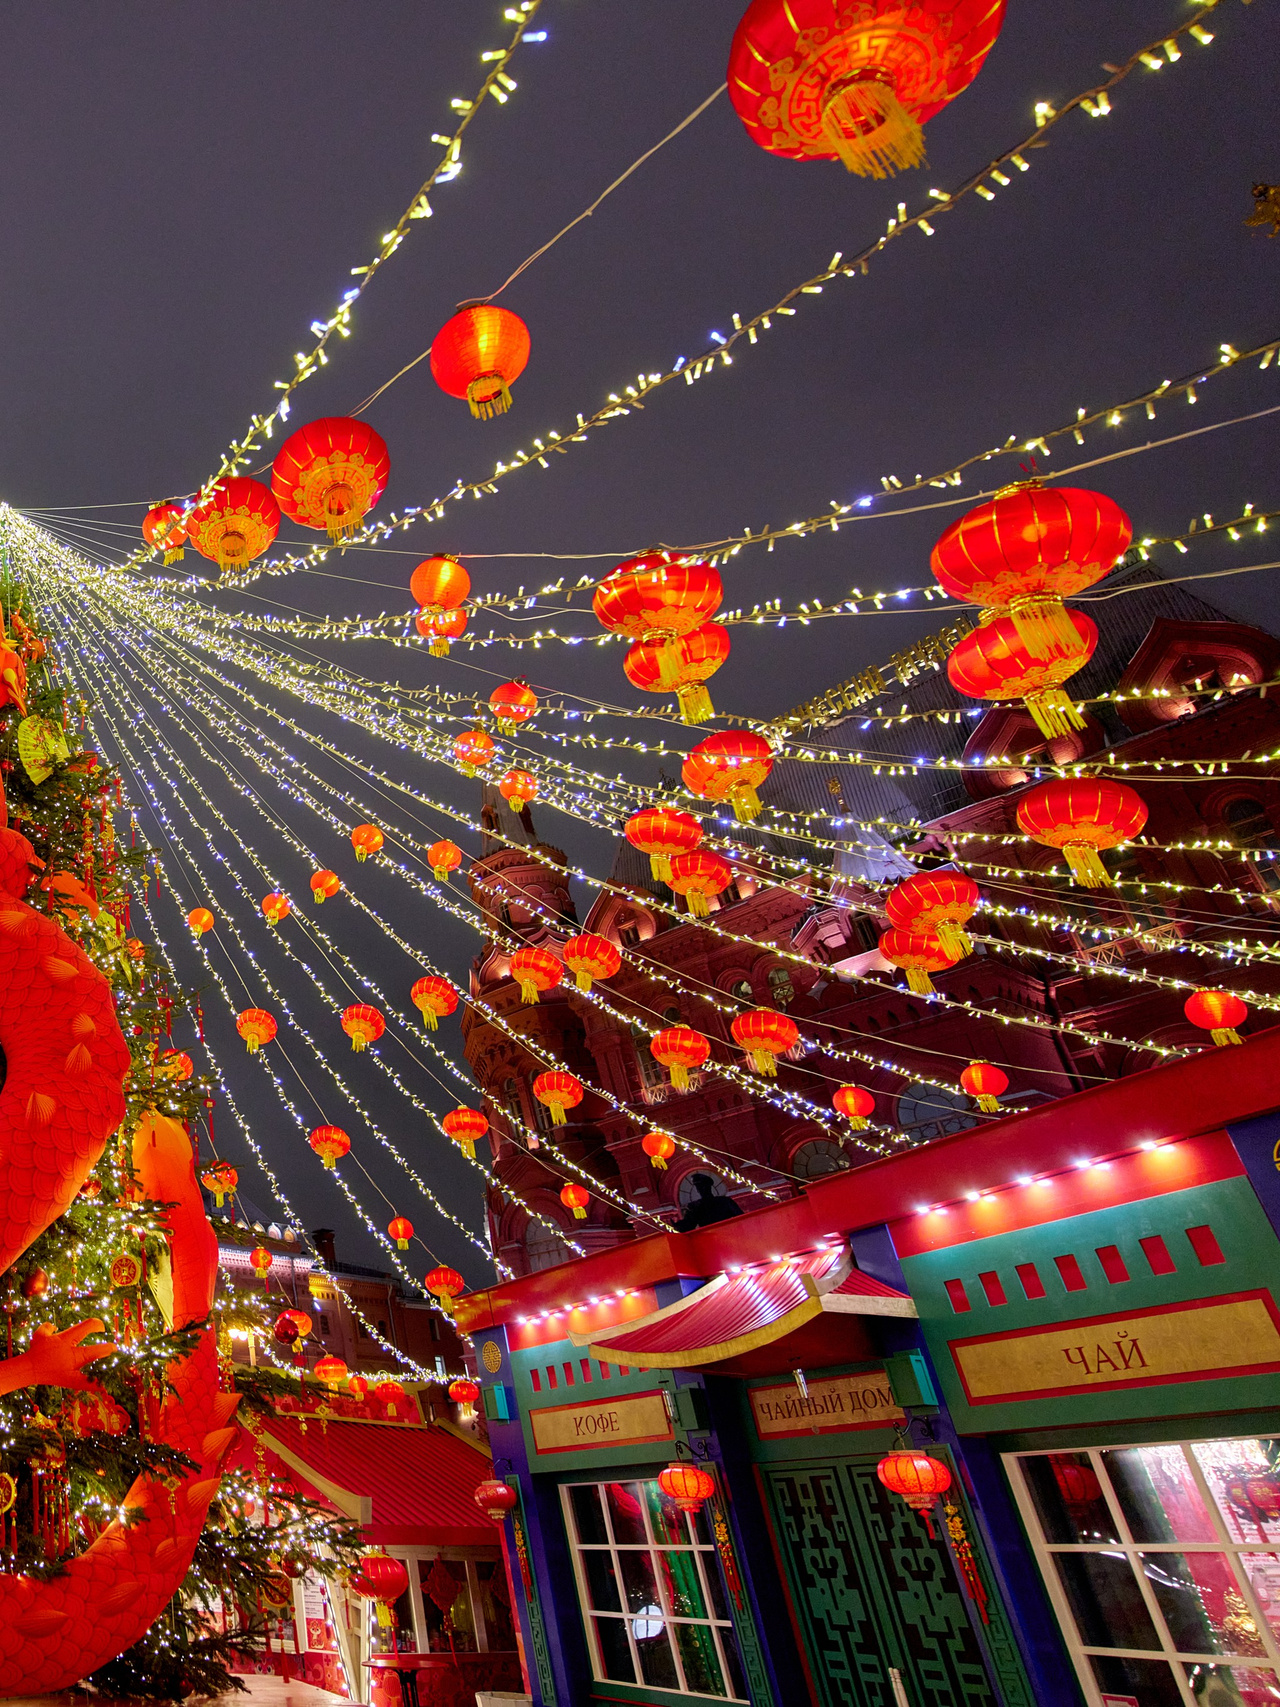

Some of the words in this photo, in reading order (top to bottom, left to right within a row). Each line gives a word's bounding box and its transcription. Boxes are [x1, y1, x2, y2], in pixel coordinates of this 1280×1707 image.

[1061, 1330, 1151, 1375] ЧАЙ
[758, 1390, 845, 1422] ЧАЙНЫЙ
[848, 1386, 896, 1414] ДОМ
[572, 1411, 620, 1437] КОФЕ
